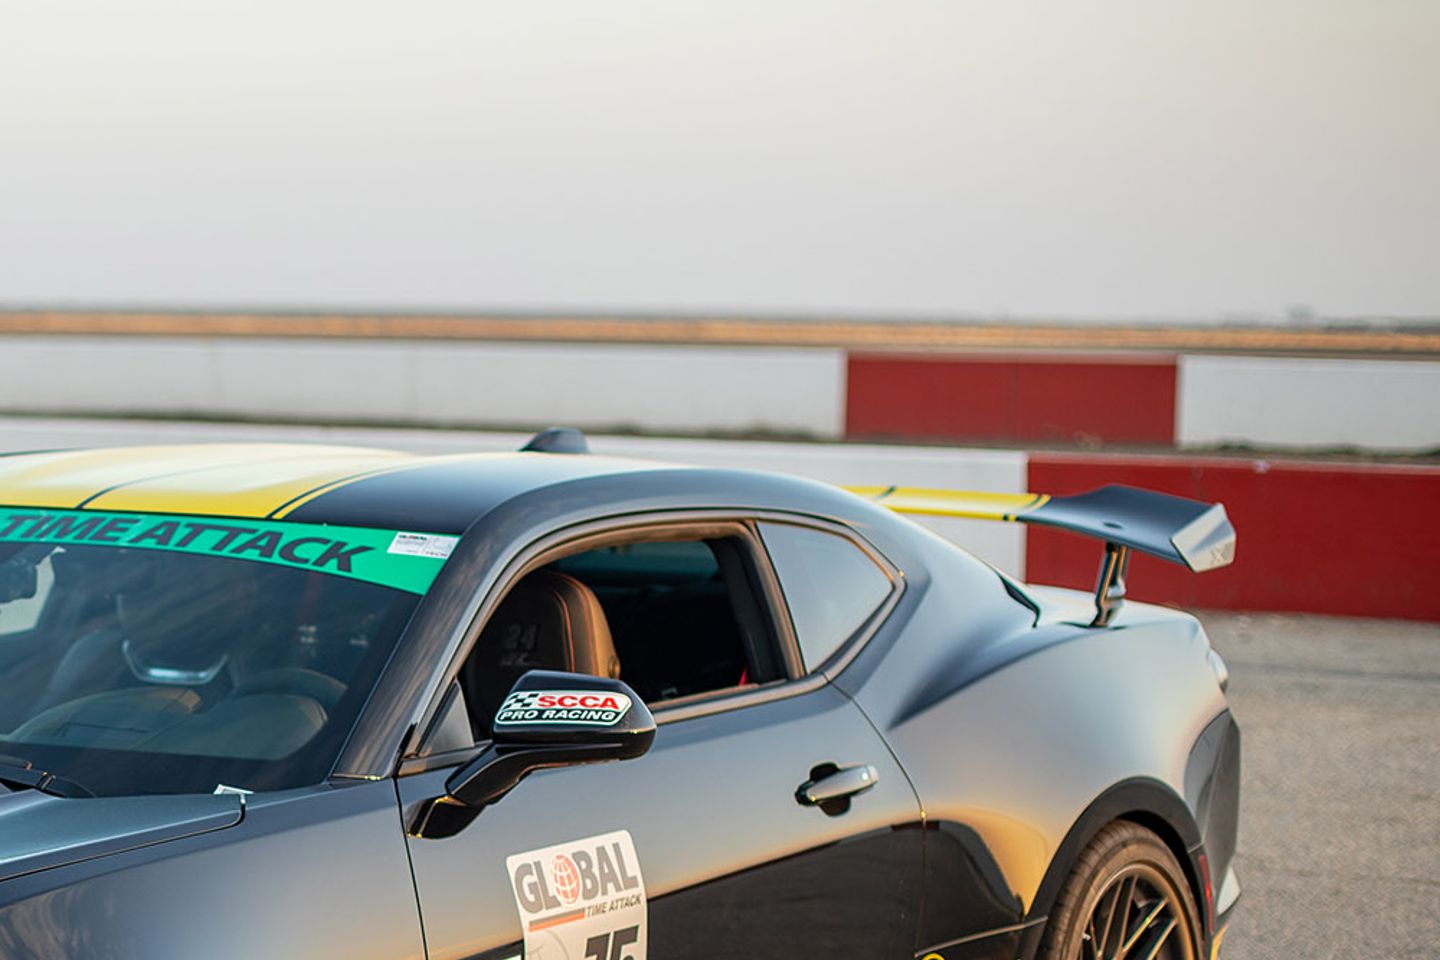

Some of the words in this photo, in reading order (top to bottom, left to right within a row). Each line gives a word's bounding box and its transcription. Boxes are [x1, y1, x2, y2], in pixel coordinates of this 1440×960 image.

[127, 519, 376, 573] ATTACK
[538, 695, 620, 709] SCCA
[500, 710, 539, 720] PRO
[542, 710, 617, 720] RACING
[515, 842, 639, 914] GLOBAL
[585, 902, 608, 918] TIME
[608, 893, 642, 913] ATTACK
